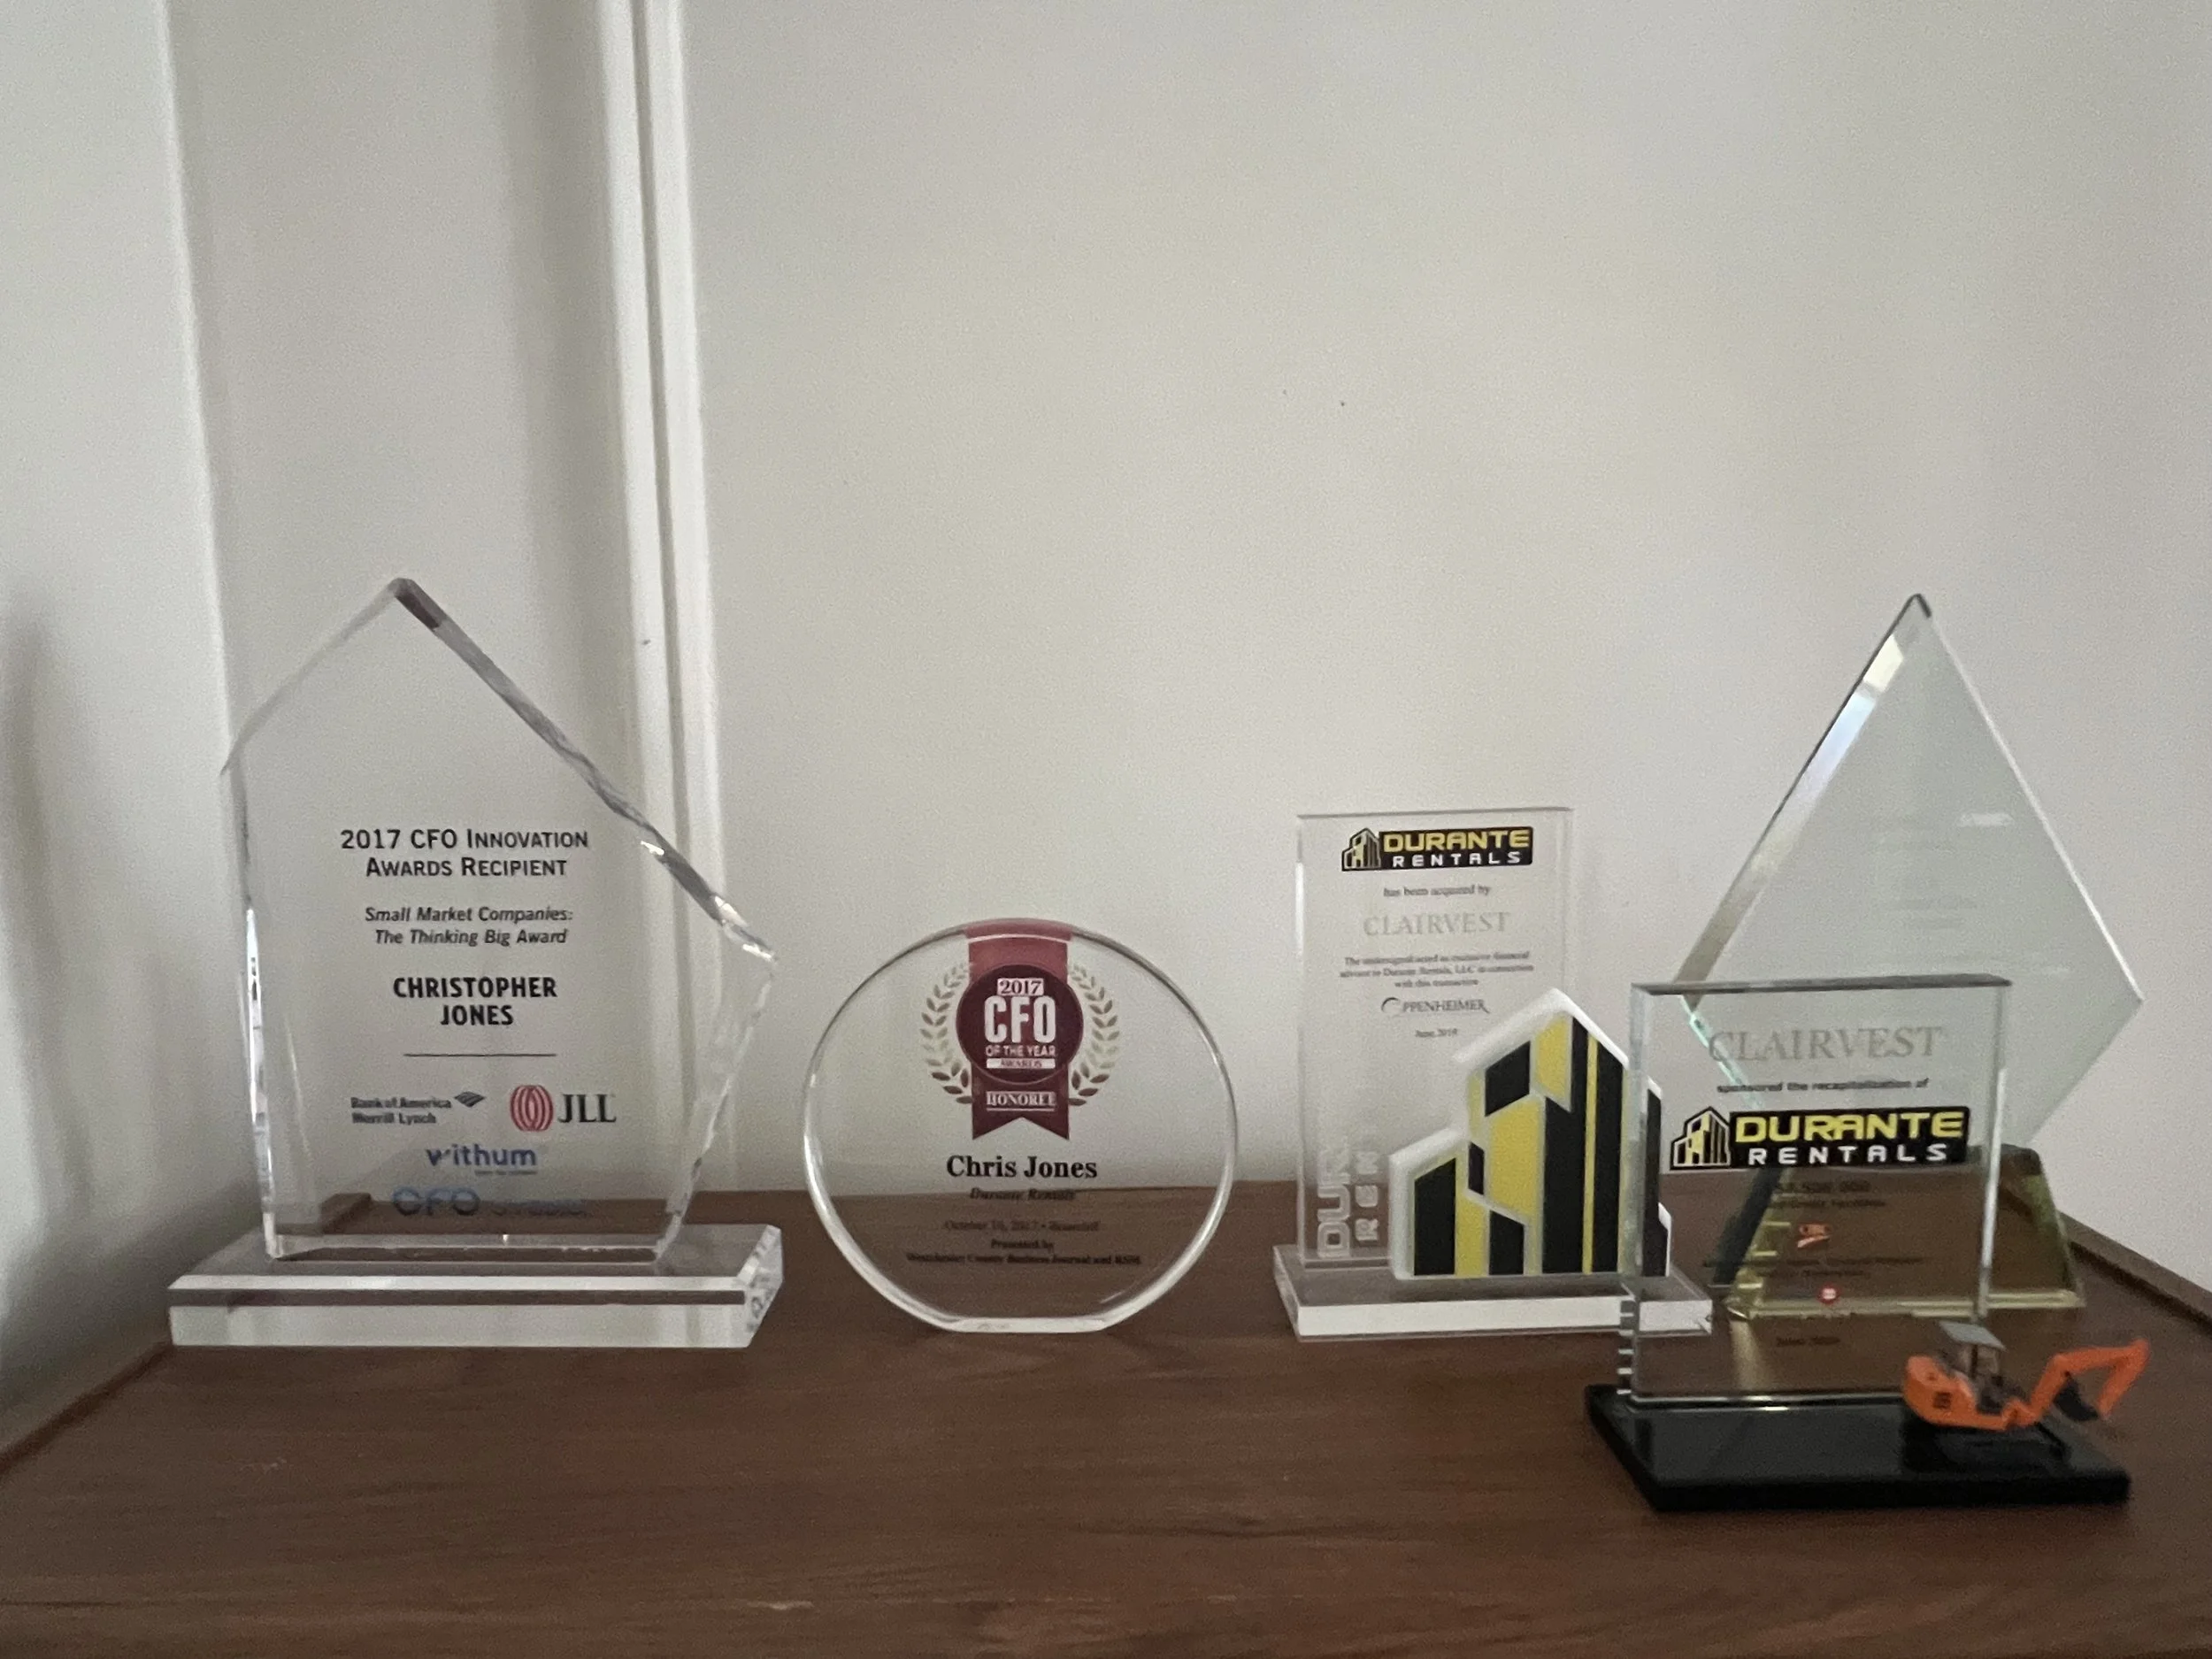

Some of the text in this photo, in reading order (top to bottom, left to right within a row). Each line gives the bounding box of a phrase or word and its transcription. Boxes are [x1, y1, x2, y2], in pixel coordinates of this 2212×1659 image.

[341, 829, 400, 849] 2017
[411, 829, 457, 849] CFO
[1383, 830, 1530, 853] DURANTE
[1392, 851, 1521, 868] RENTALS
[365, 907, 573, 925] Small Market Companies:
[1363, 911, 1511, 936] CLAIRVEST
[375, 929, 568, 947] The Thinking Big Award
[393, 977, 557, 998] CHRISTOPHER
[1000, 980, 1041, 995] 2017
[441, 1004, 514, 1025] JONES
[984, 995, 1056, 1043] CFO
[986, 1045, 1056, 1056] OF THE YEAR
[1709, 1026, 1942, 1062] CLAIRVEST
[557, 1094, 617, 1124] JLL
[987, 1092, 1056, 1106] HONOREE
[1735, 1111, 1965, 1142] DURANTE
[1747, 1143, 1948, 1166] RENTALS
[946, 1155, 1098, 1179] Chris Jones
